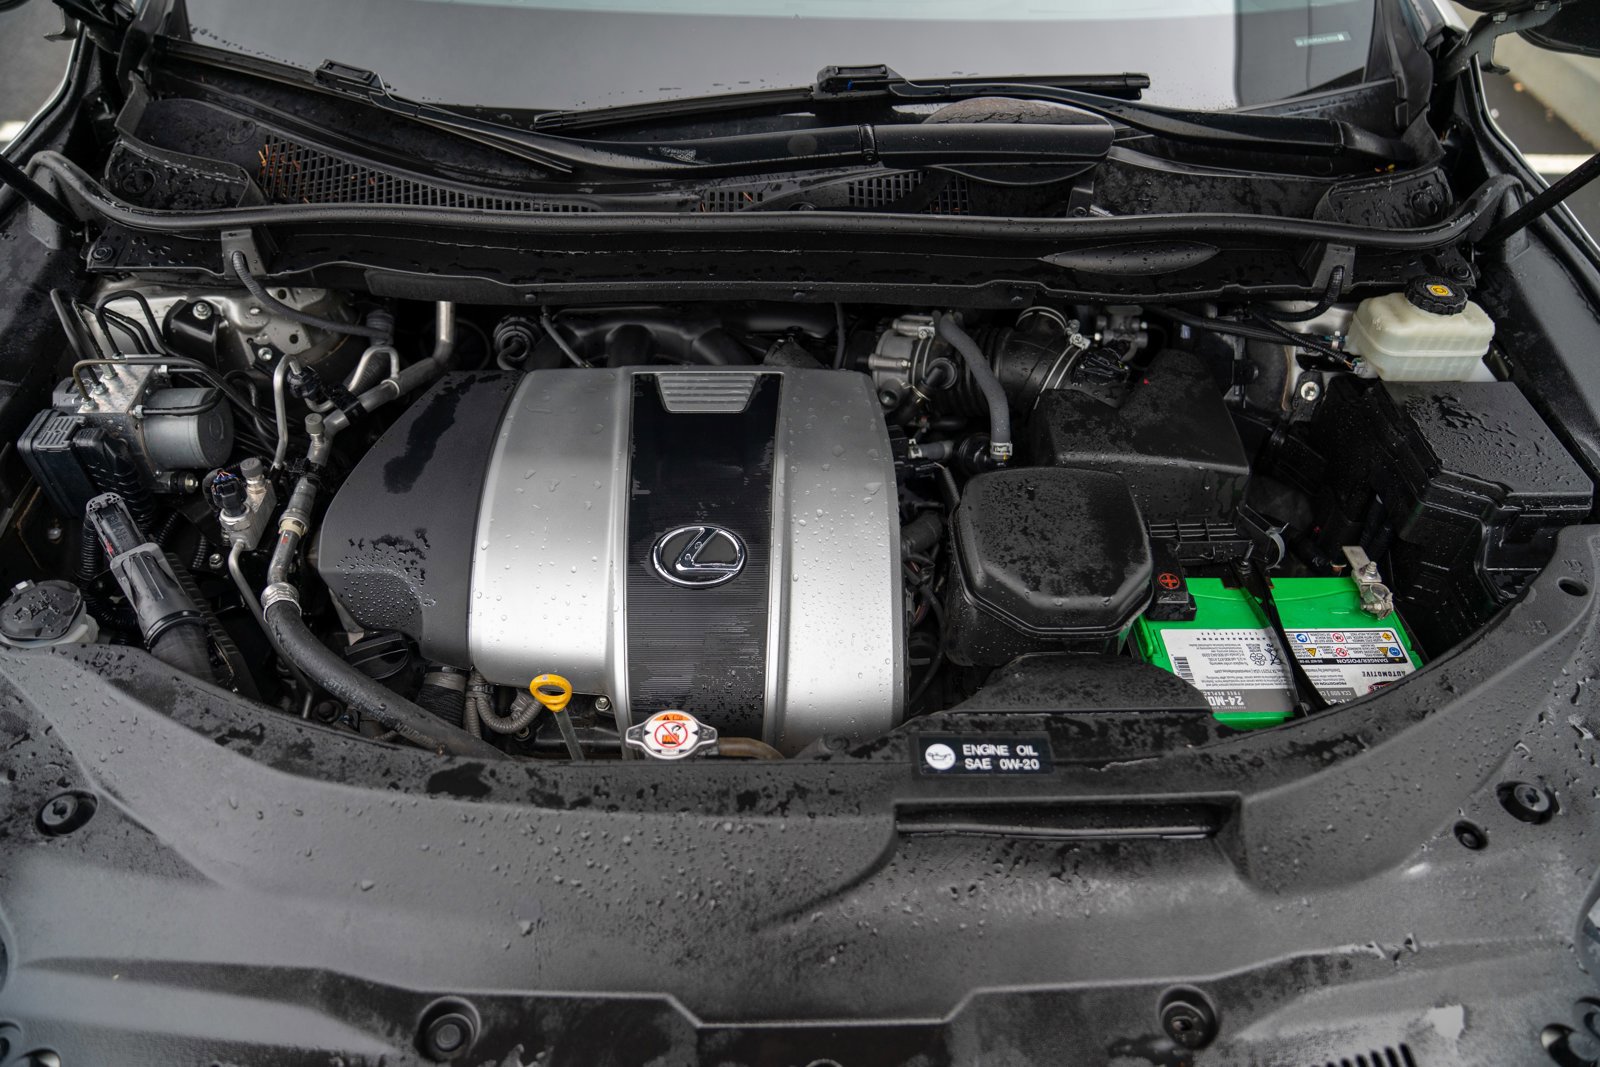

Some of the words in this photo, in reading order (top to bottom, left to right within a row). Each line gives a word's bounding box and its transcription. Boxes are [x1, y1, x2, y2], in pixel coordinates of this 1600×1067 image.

[1204, 695, 1245, 706] 24-MO
[962, 744, 1009, 756] ENGINE
[1016, 745, 1039, 756] OIL
[964, 758, 992, 770] SAE
[999, 759, 1040, 770] 0W-20
